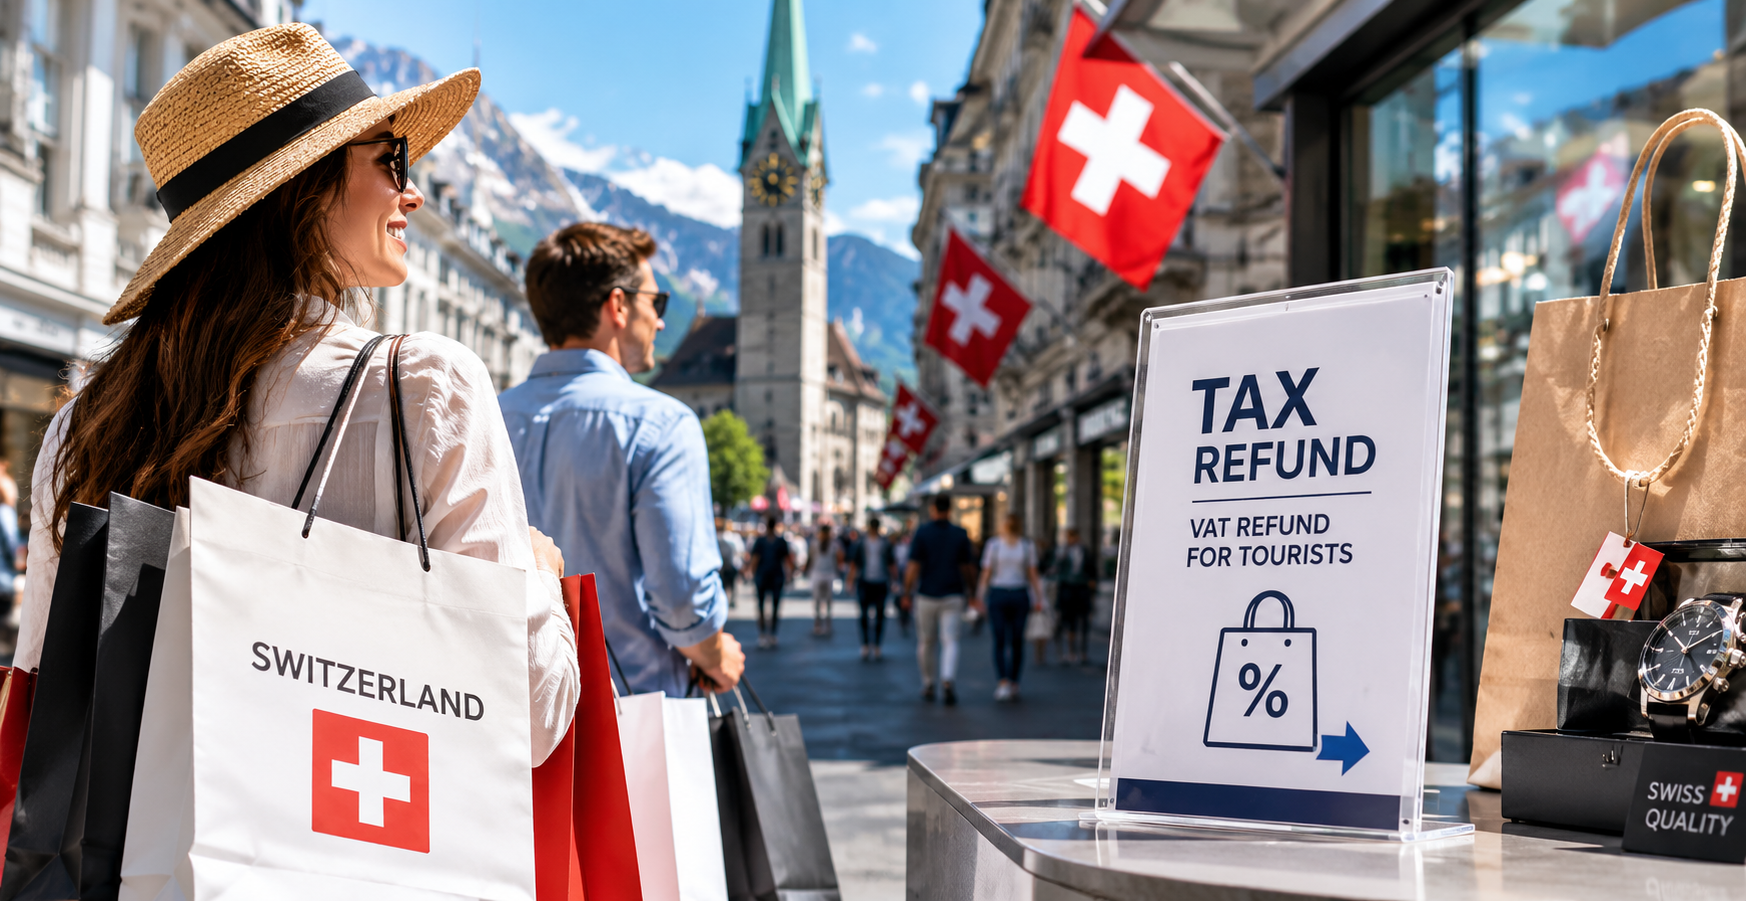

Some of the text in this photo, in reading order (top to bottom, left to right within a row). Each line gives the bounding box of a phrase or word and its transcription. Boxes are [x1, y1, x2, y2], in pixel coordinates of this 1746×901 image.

[1192, 367, 1320, 435] TAX
[1193, 434, 1377, 484] REFUND
[1190, 513, 1330, 538] VAT REFUND
[1186, 542, 1354, 568] FOR TOURISTS
[251, 641, 485, 721] SWITZERLAND
[1238, 662, 1289, 719] %
[1647, 781, 1706, 805] SWISS
[1645, 808, 1734, 837] QUALITY
